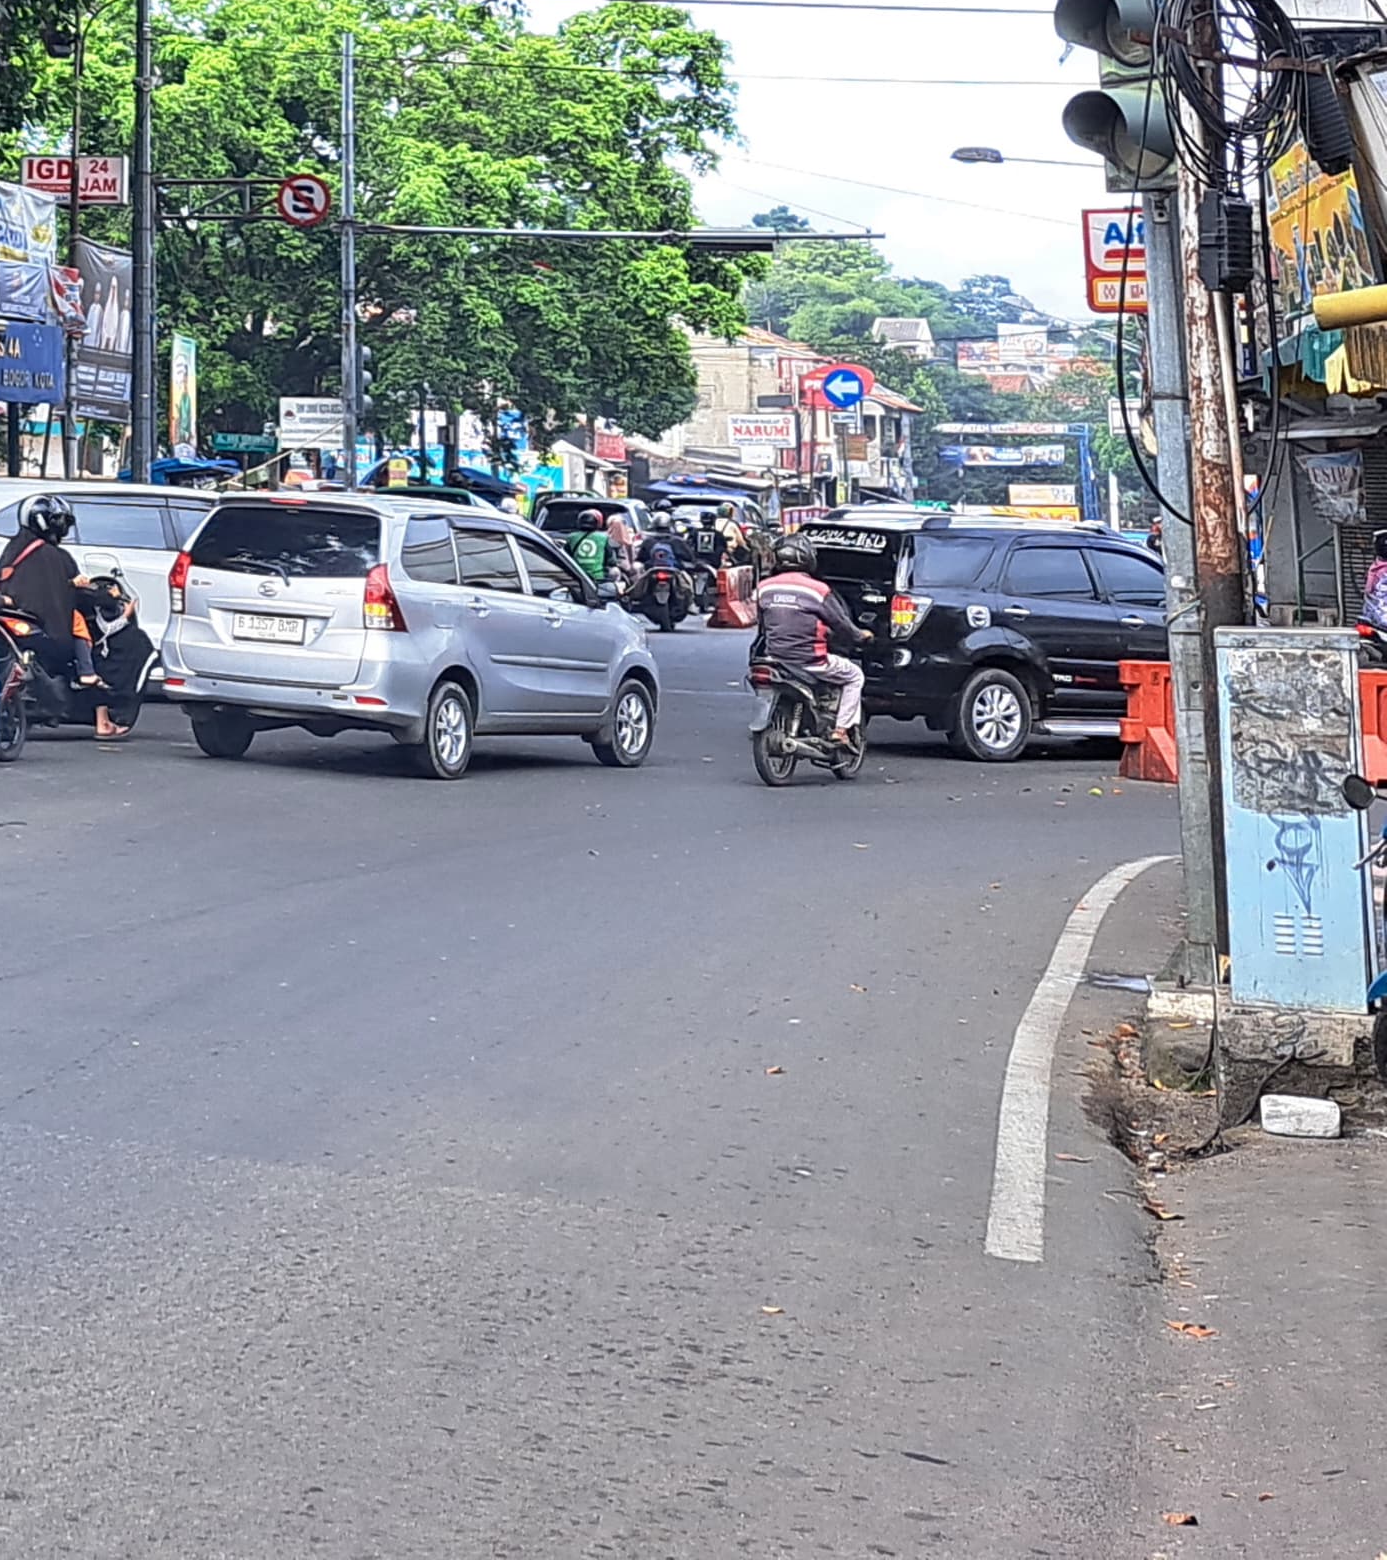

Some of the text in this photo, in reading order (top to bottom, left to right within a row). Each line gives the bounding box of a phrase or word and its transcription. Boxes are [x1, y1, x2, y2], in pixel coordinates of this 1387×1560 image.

[27, 159, 73, 180] IGD
[89, 159, 109, 174] 24
[79, 178, 118, 193] JAM
[6, 338, 21, 359] 4A
[35, 370, 54, 389] KOTA
[732, 425, 791, 438] NARUMI
